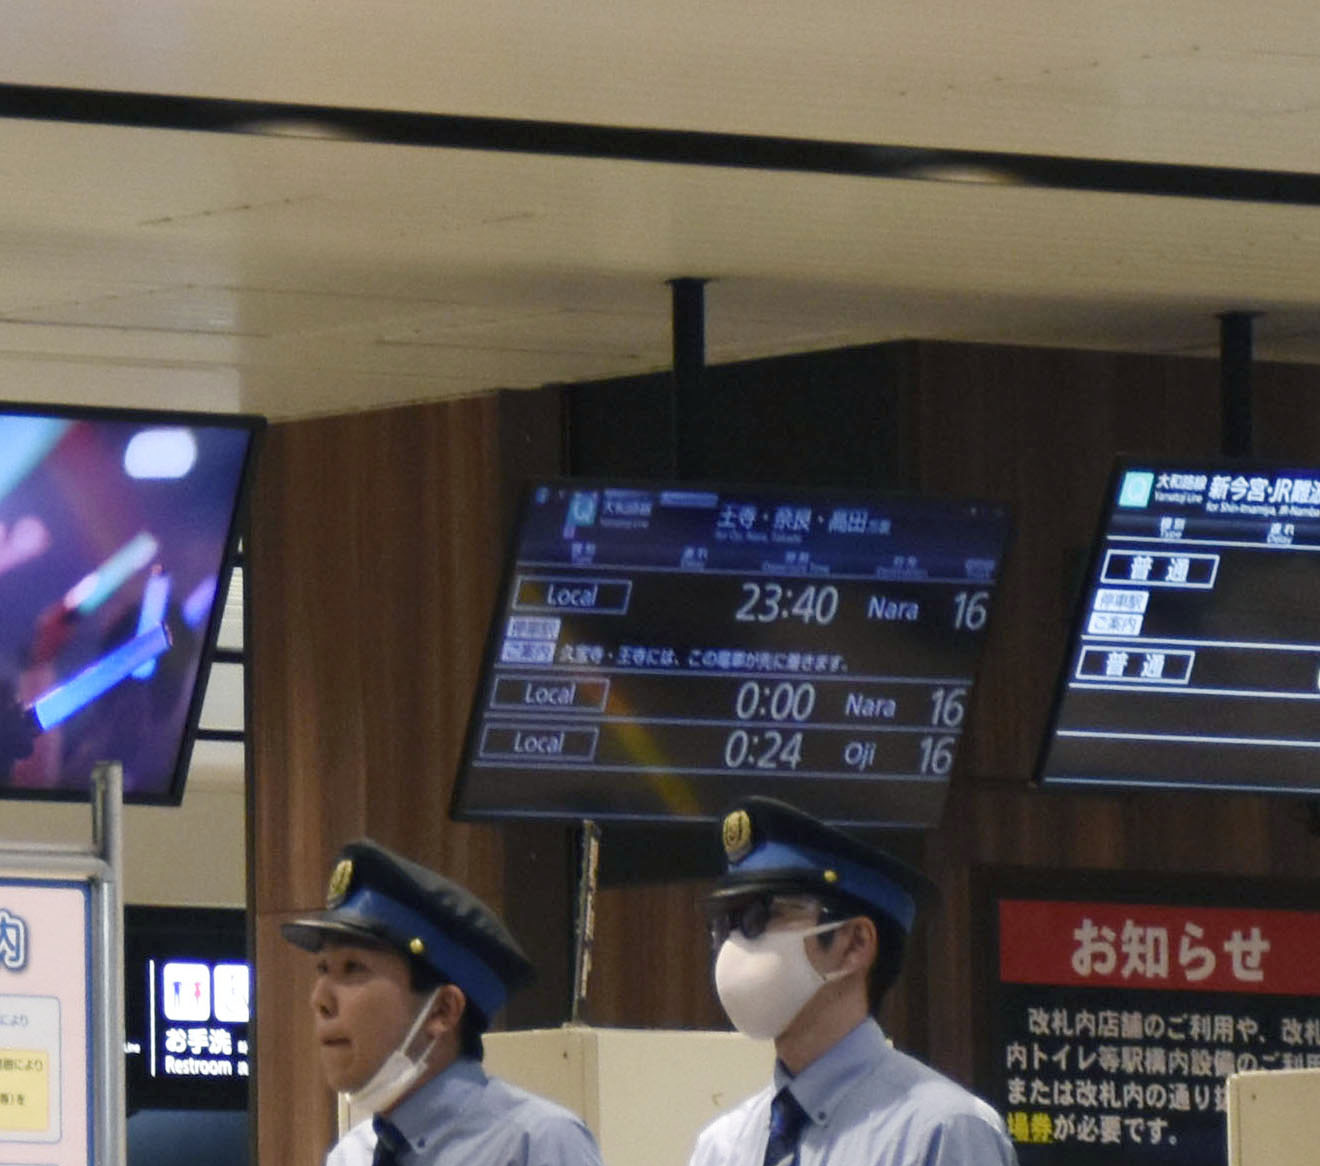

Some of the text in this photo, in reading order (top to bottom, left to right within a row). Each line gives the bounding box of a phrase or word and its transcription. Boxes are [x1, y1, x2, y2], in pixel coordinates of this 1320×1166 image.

[546, 584, 988, 630] Local 23:40 Nara 16
[525, 681, 964, 727] Local 0:00 Nara 16
[513, 732, 565, 755] Local
[725, 730, 803, 770] 0:24
[921, 736, 953, 775] 16
[1071, 917, 1271, 983] お知らせ
[165, 1028, 233, 1055] お手洗
[165, 1055, 233, 1076] Restroom
